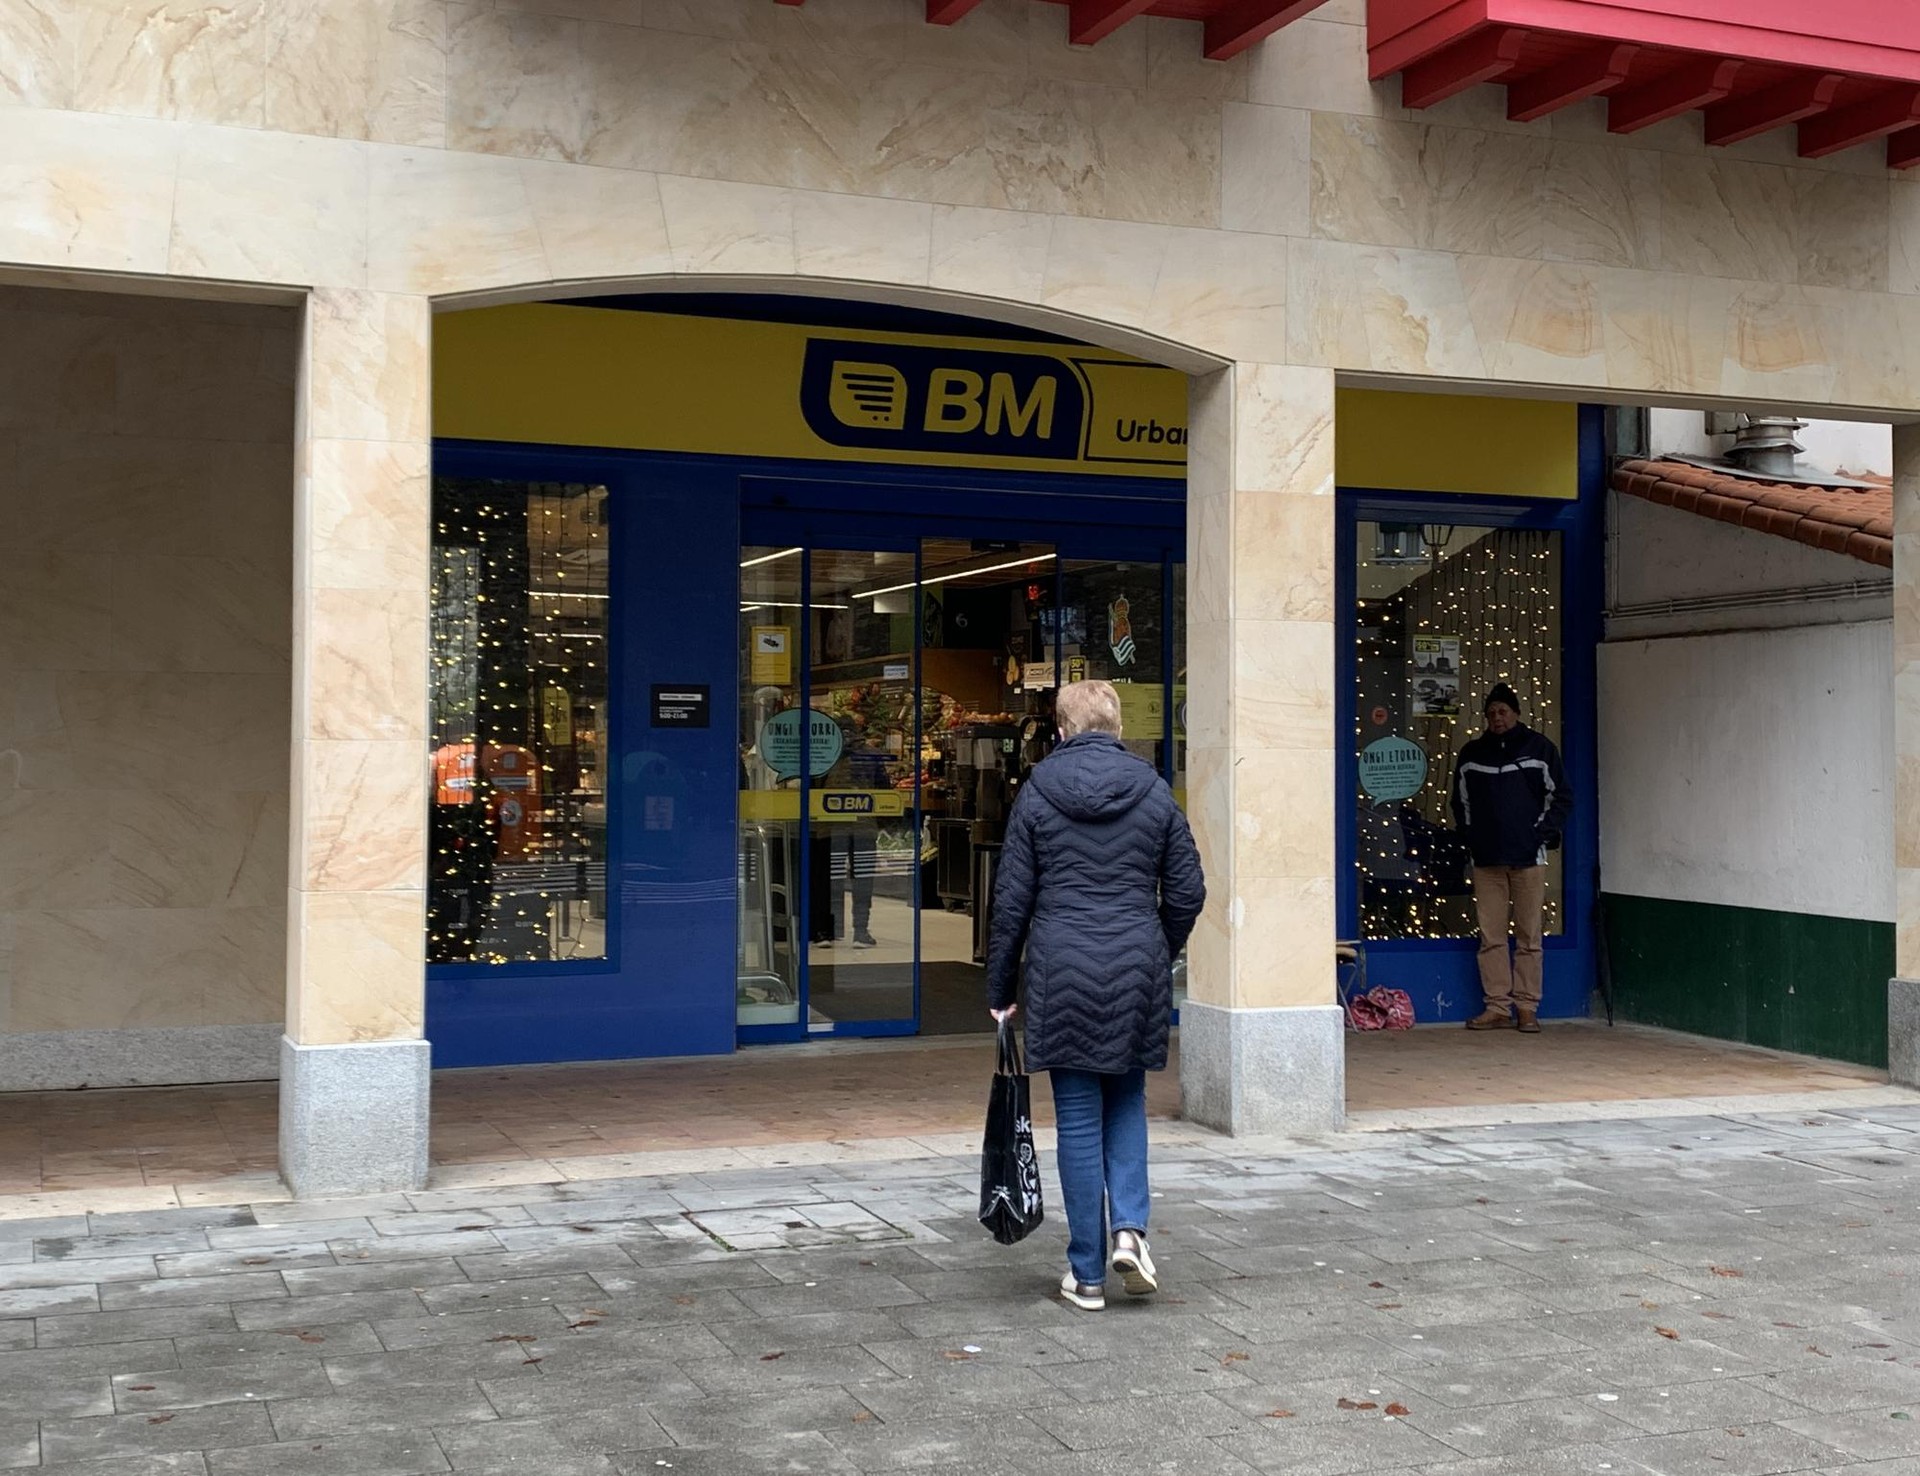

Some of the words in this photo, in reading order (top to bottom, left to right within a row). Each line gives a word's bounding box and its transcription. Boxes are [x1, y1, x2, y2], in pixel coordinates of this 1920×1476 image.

[924, 368, 1057, 440] BM
[1363, 751, 1385, 763] ONGI
[1389, 749, 1421, 763] ETORRI
[844, 796, 869, 810] BM
